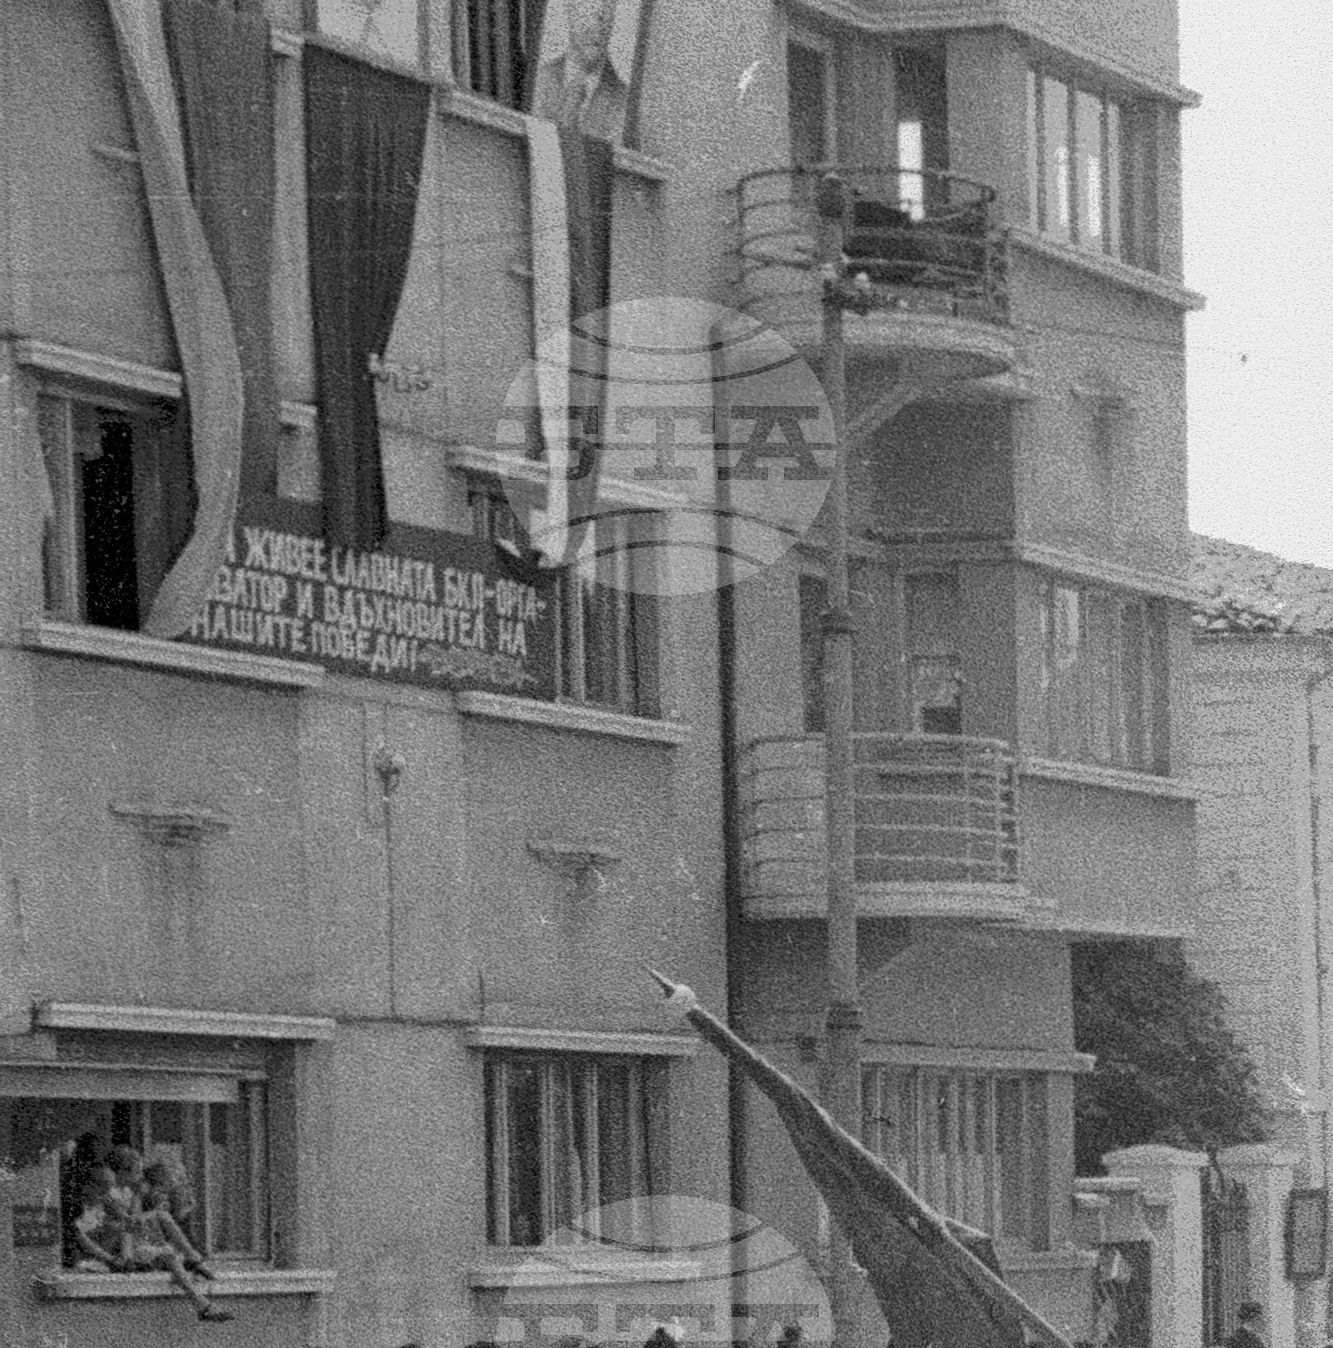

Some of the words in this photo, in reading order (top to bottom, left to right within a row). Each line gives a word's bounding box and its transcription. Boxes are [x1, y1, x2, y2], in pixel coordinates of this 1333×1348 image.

[243, 526, 327, 580] ЖИВЕЕ
[330, 548, 436, 601] СЛАВНАТА
[190, 603, 307, 651] НАШИТЕ
[311, 621, 420, 673] ПОБЕДИ!
[209, 564, 288, 613] ЗАТОР
[296, 579, 315, 618] И
[322, 585, 486, 650] ВДЪХНОВИТЕЛ
[498, 619, 528, 656] НА
